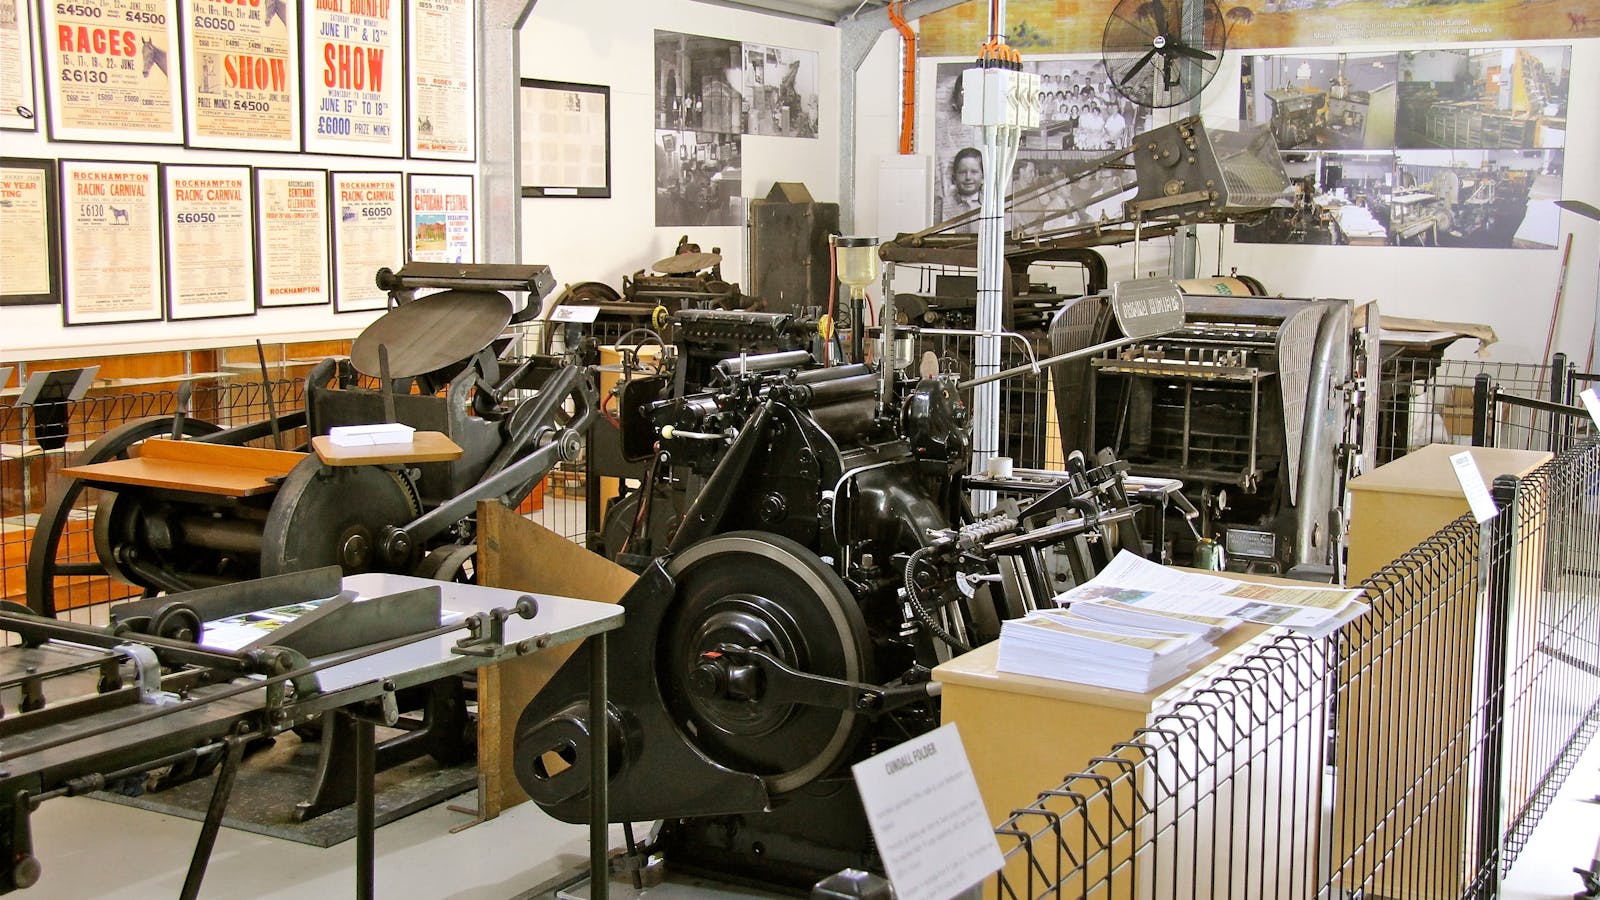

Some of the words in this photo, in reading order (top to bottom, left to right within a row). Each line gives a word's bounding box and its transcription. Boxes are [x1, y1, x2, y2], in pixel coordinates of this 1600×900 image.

[57, 3, 101, 18] £4500
[248, 10, 260, 20] JUNE
[126, 11, 166, 24] £4500
[194, 16, 235, 31] £6050
[353, 16, 361, 25] AND
[320, 22, 340, 38] JUNE
[344, 24, 358, 38] 11TH
[362, 28, 368, 42] &
[372, 30, 388, 42] 13TH
[58, 24, 136, 57] RACES
[120, 58, 136, 70] JUNE
[324, 42, 384, 92] SHOW
[62, 69, 108, 84] £6130
[224, 54, 286, 92] SHOW
[198, 98, 211, 108] PRIZE
[214, 98, 231, 110] MONEY
[234, 100, 270, 112] £4500
[320, 98, 340, 113] JUNE
[362, 102, 372, 115] TO
[318, 116, 350, 135] £6000
[354, 124, 370, 135] PRIZE
[374, 124, 390, 136] MONEY
[74, 172, 148, 181] ROCKHAMPTON
[78, 183, 105, 196] RACING
[110, 184, 146, 196] CARNIVAL
[176, 190, 203, 201] RACING
[206, 190, 242, 200] CARNIVAL
[288, 188, 314, 198] CENTENARY
[342, 191, 364, 202] RACING
[366, 191, 395, 201] CARNIVAL
[446, 194, 468, 211] FESTIVAL
[80, 204, 104, 216] £6130
[362, 208, 392, 216] £6050
[177, 212, 216, 223] £6050
[270, 286, 320, 295] ROCKHAMPTON
[885, 754, 914, 776] CUNDALL
[913, 742, 938, 764] FOLDER
